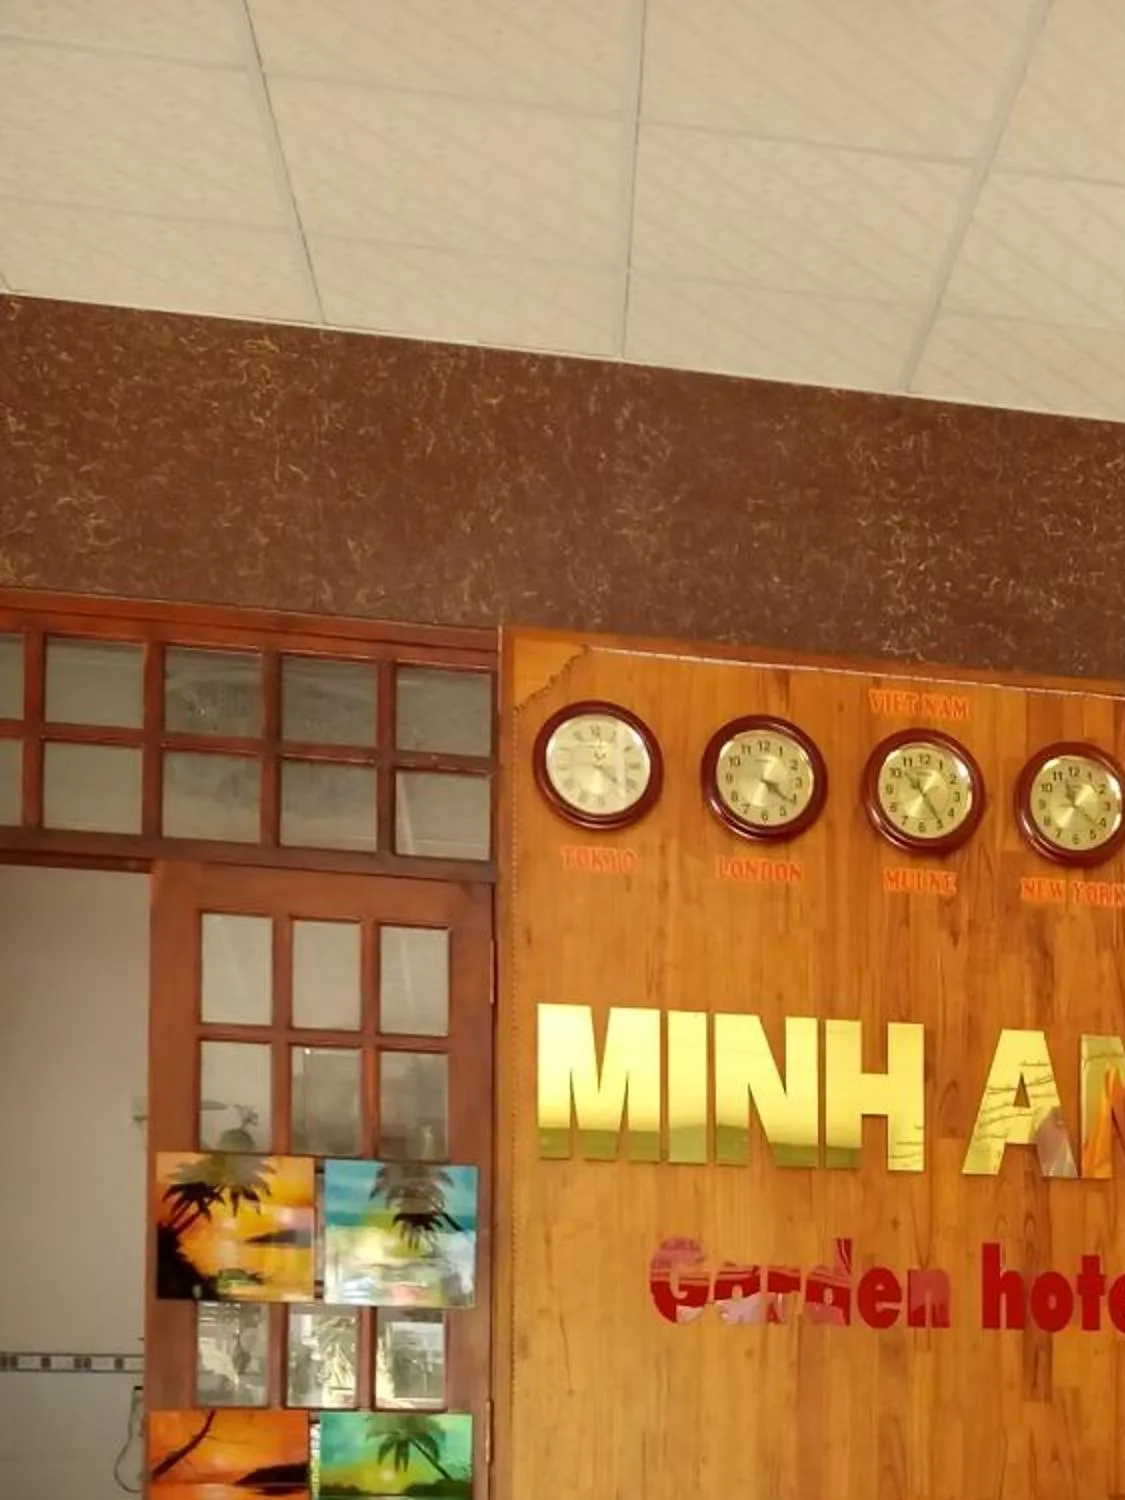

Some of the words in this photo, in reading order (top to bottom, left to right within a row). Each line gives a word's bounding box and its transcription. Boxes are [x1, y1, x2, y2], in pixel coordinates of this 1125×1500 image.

[921, 693, 970, 720] NAM
[561, 846, 641, 873] TOKYO
[716, 855, 803, 882] LONDON
[1020, 877, 1066, 901] NEW
[537, 1003, 924, 1172] MINH
[649, 1236, 951, 1329] Garden
